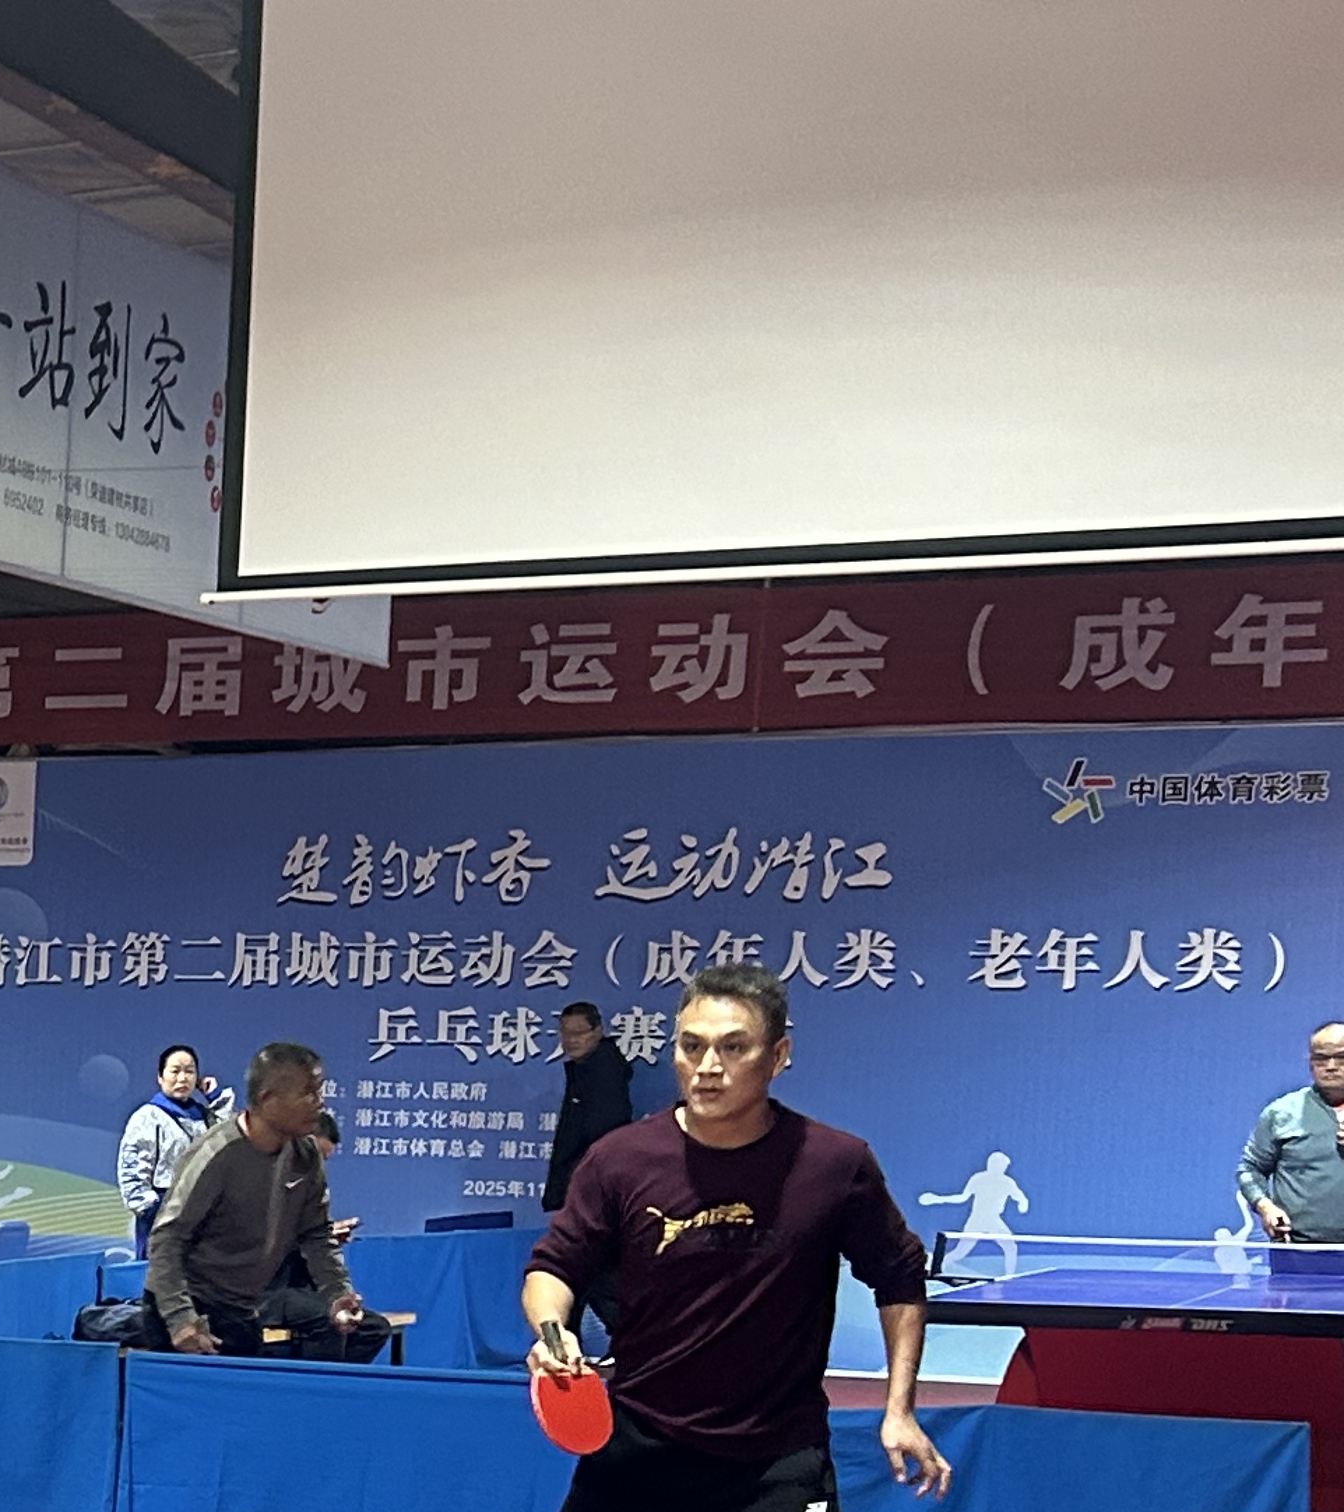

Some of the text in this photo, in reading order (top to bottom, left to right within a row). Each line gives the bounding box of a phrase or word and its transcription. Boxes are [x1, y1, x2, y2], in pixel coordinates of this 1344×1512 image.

[1128, 770, 1330, 806] 中国体育彩票
[278, 826, 894, 907] 楚韵虾香 运动潜江
